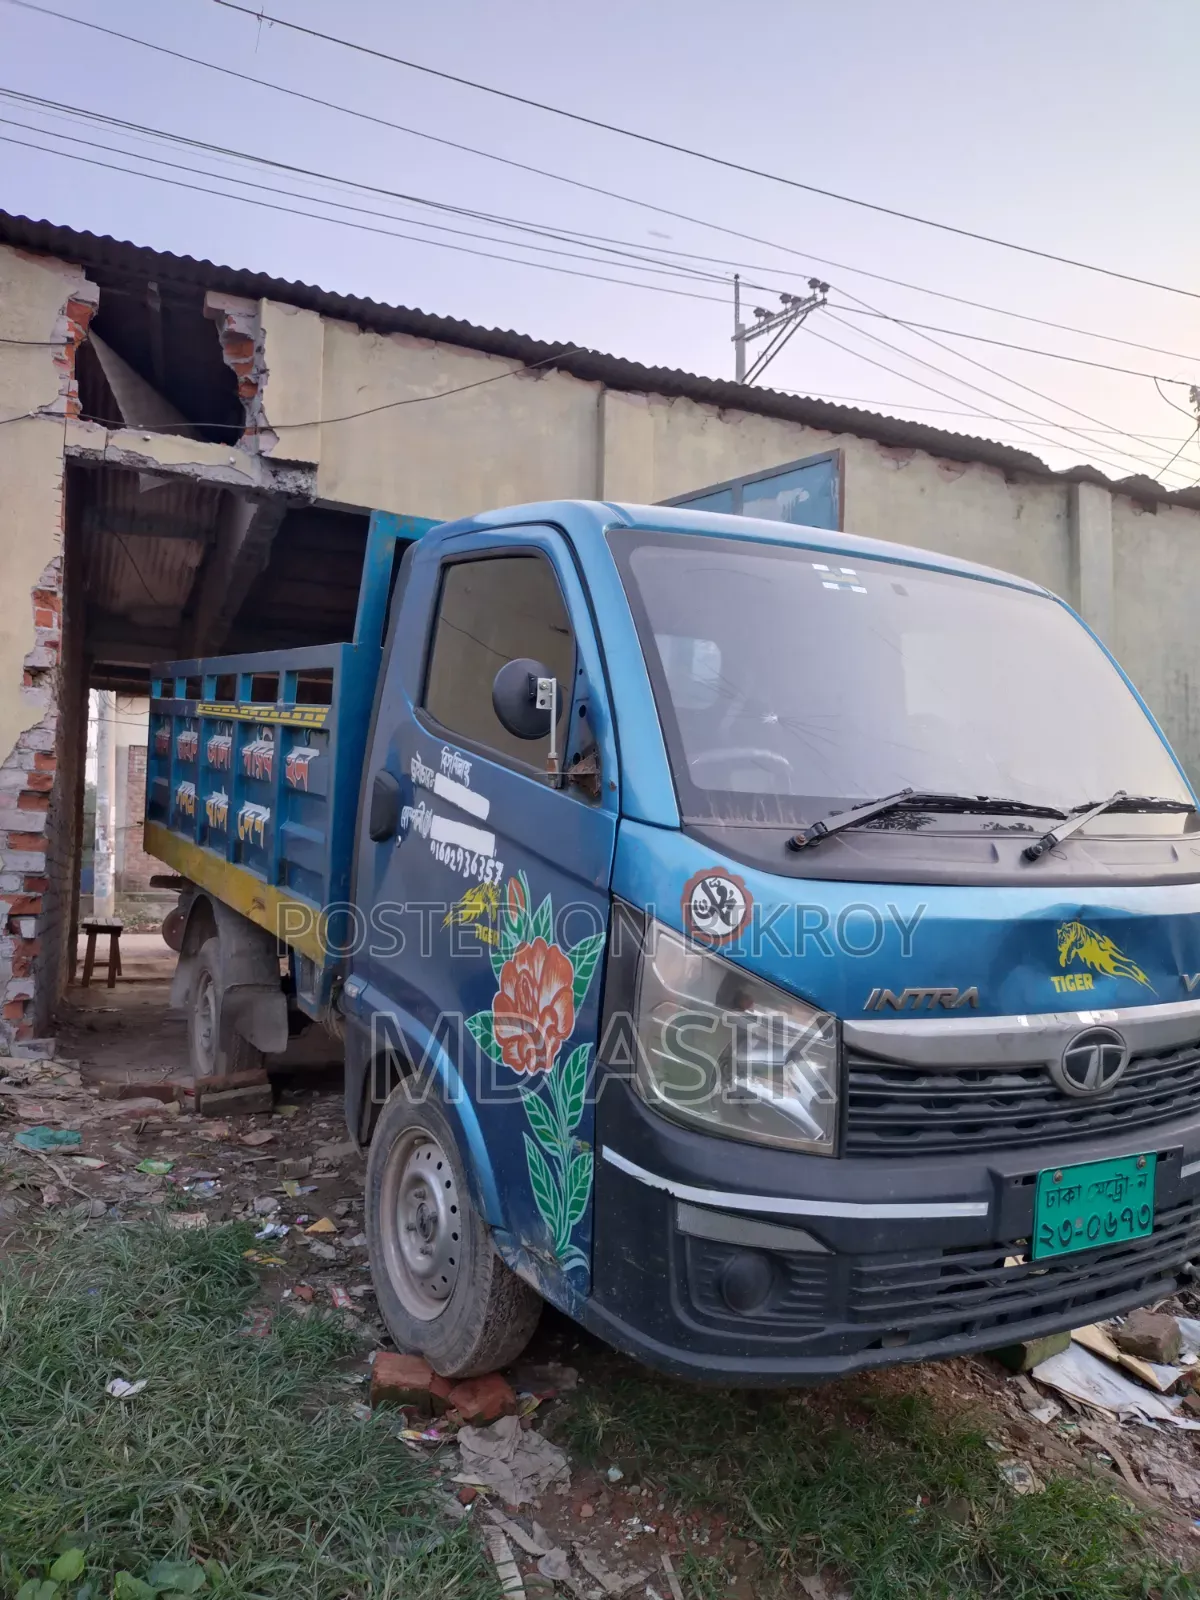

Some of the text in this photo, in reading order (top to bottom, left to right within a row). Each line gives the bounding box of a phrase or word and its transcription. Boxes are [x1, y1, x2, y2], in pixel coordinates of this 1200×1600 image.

[1051, 973, 1095, 993] TIGER
[862, 985, 980, 1012] INTRA
[1045, 1184, 1082, 1208] ঢাকা
[1039, 1204, 1151, 1249] ২৩-০৬৭৩
